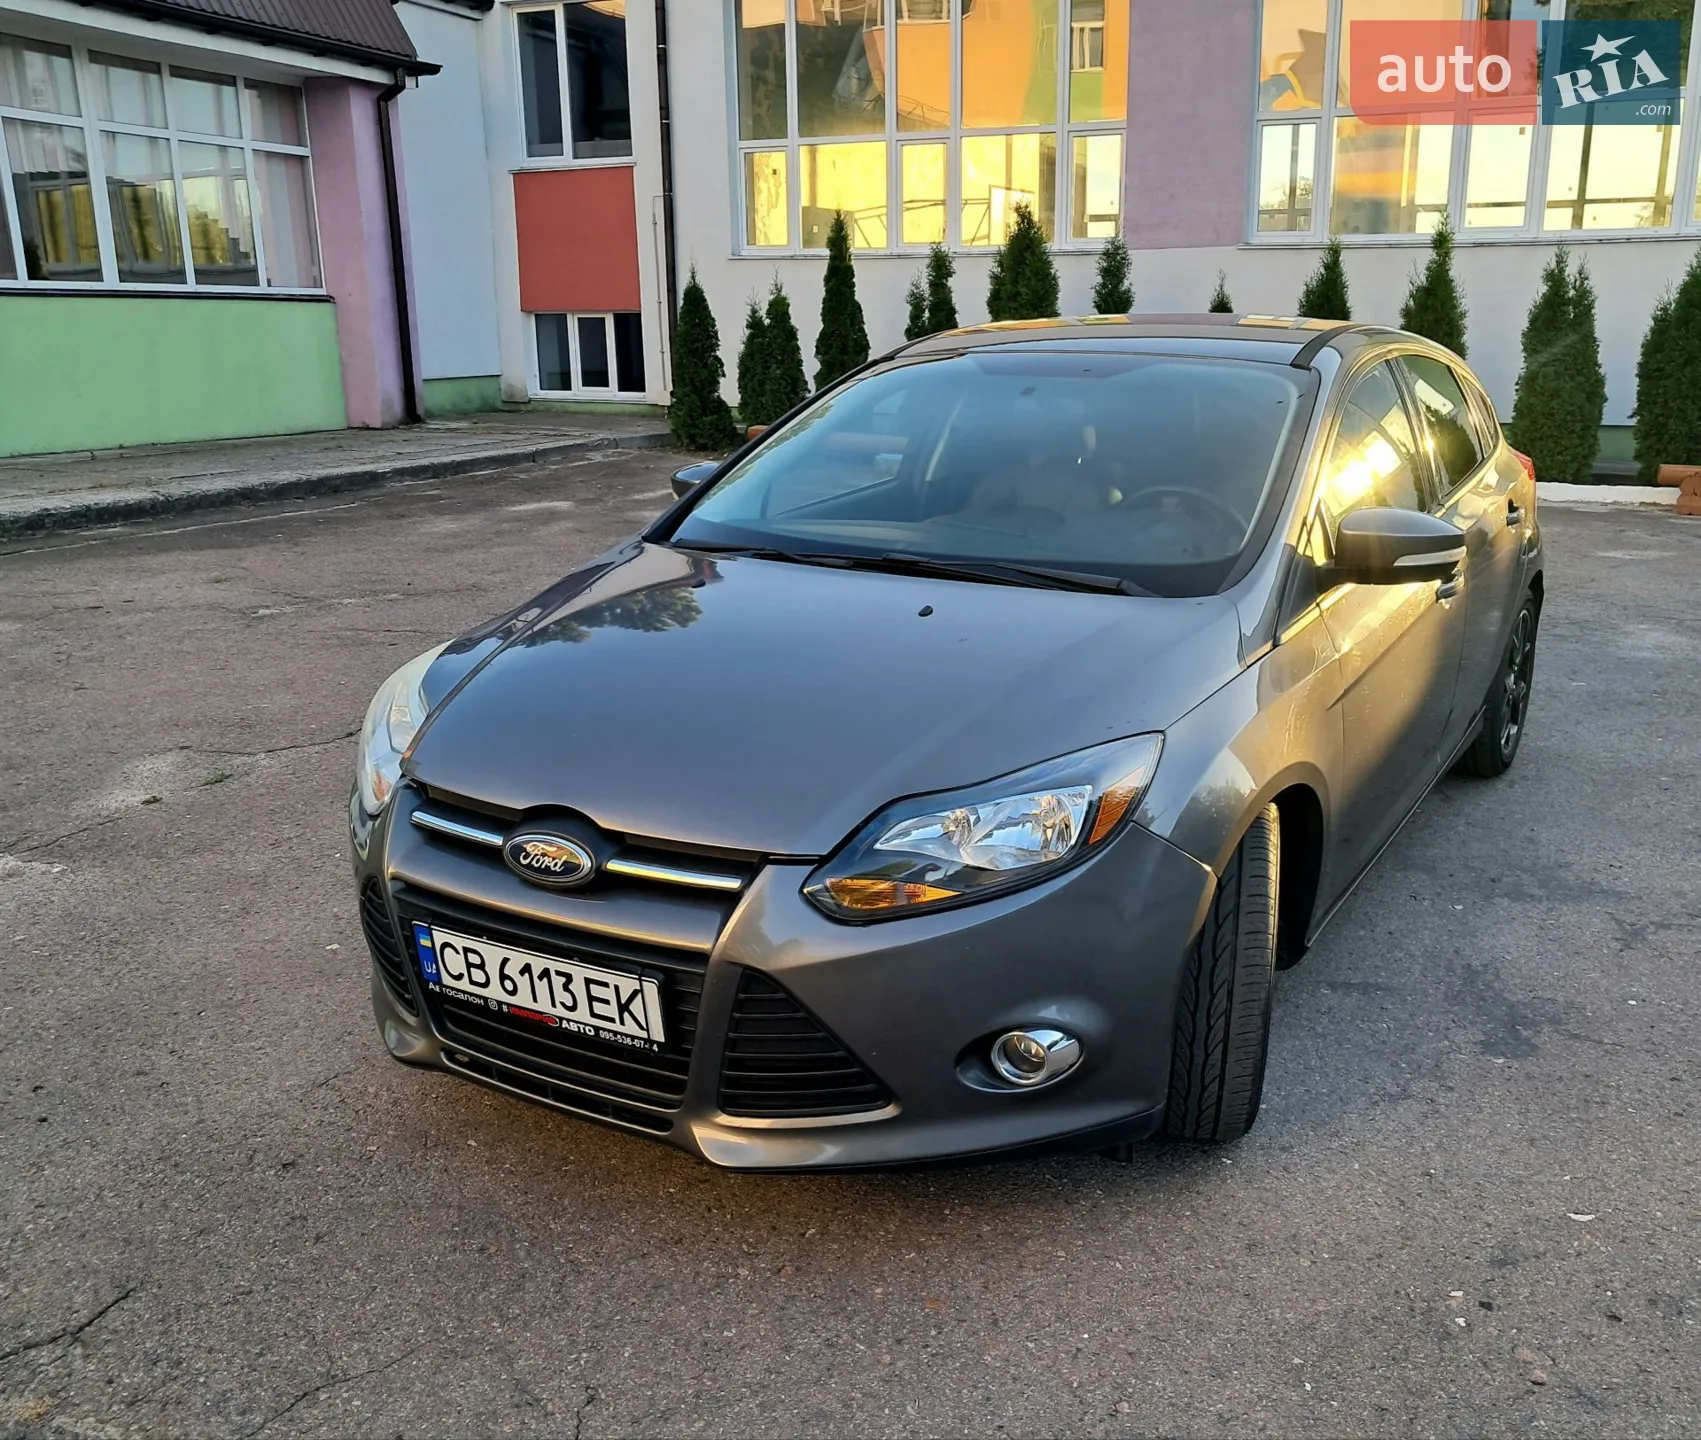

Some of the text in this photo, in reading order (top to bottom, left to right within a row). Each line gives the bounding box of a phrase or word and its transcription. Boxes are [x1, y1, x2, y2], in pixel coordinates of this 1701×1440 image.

[519, 841, 568, 872] Ford
[424, 960, 437, 974] UA
[439, 941, 648, 1032] CB 6113 EK
[561, 1019, 595, 1036] АВТО
